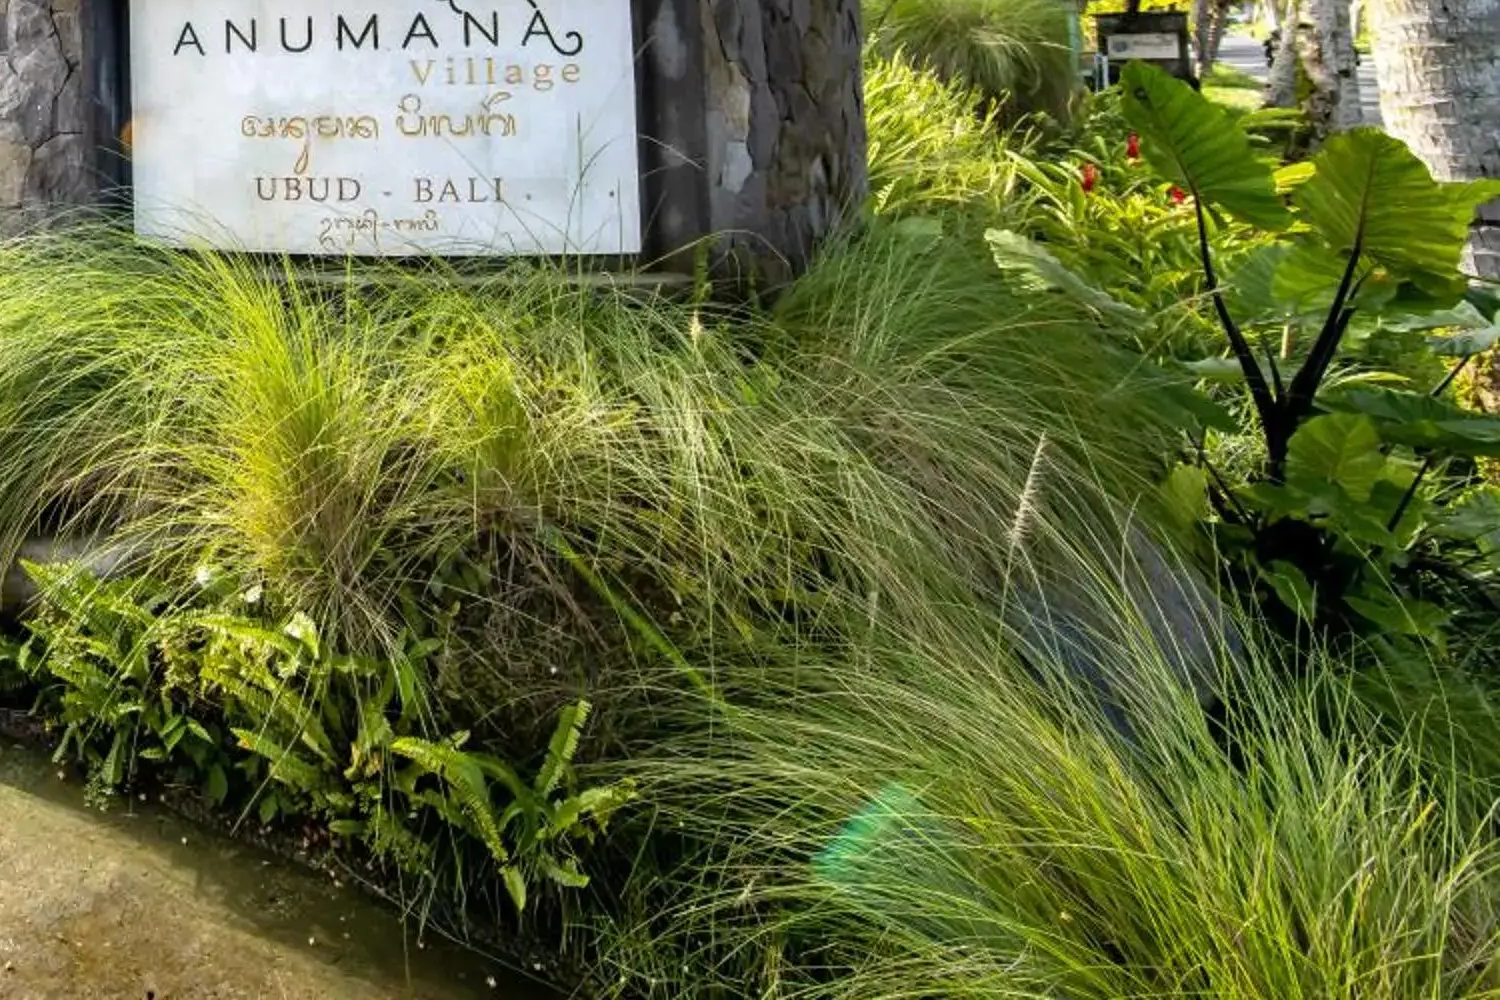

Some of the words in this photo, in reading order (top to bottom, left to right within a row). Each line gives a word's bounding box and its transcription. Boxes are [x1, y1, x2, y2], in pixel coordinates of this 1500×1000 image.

[173, 9, 583, 56] ANUMANA
[409, 56, 580, 91] Village
[254, 176, 362, 202] UBUD
[413, 176, 505, 202] BALI
